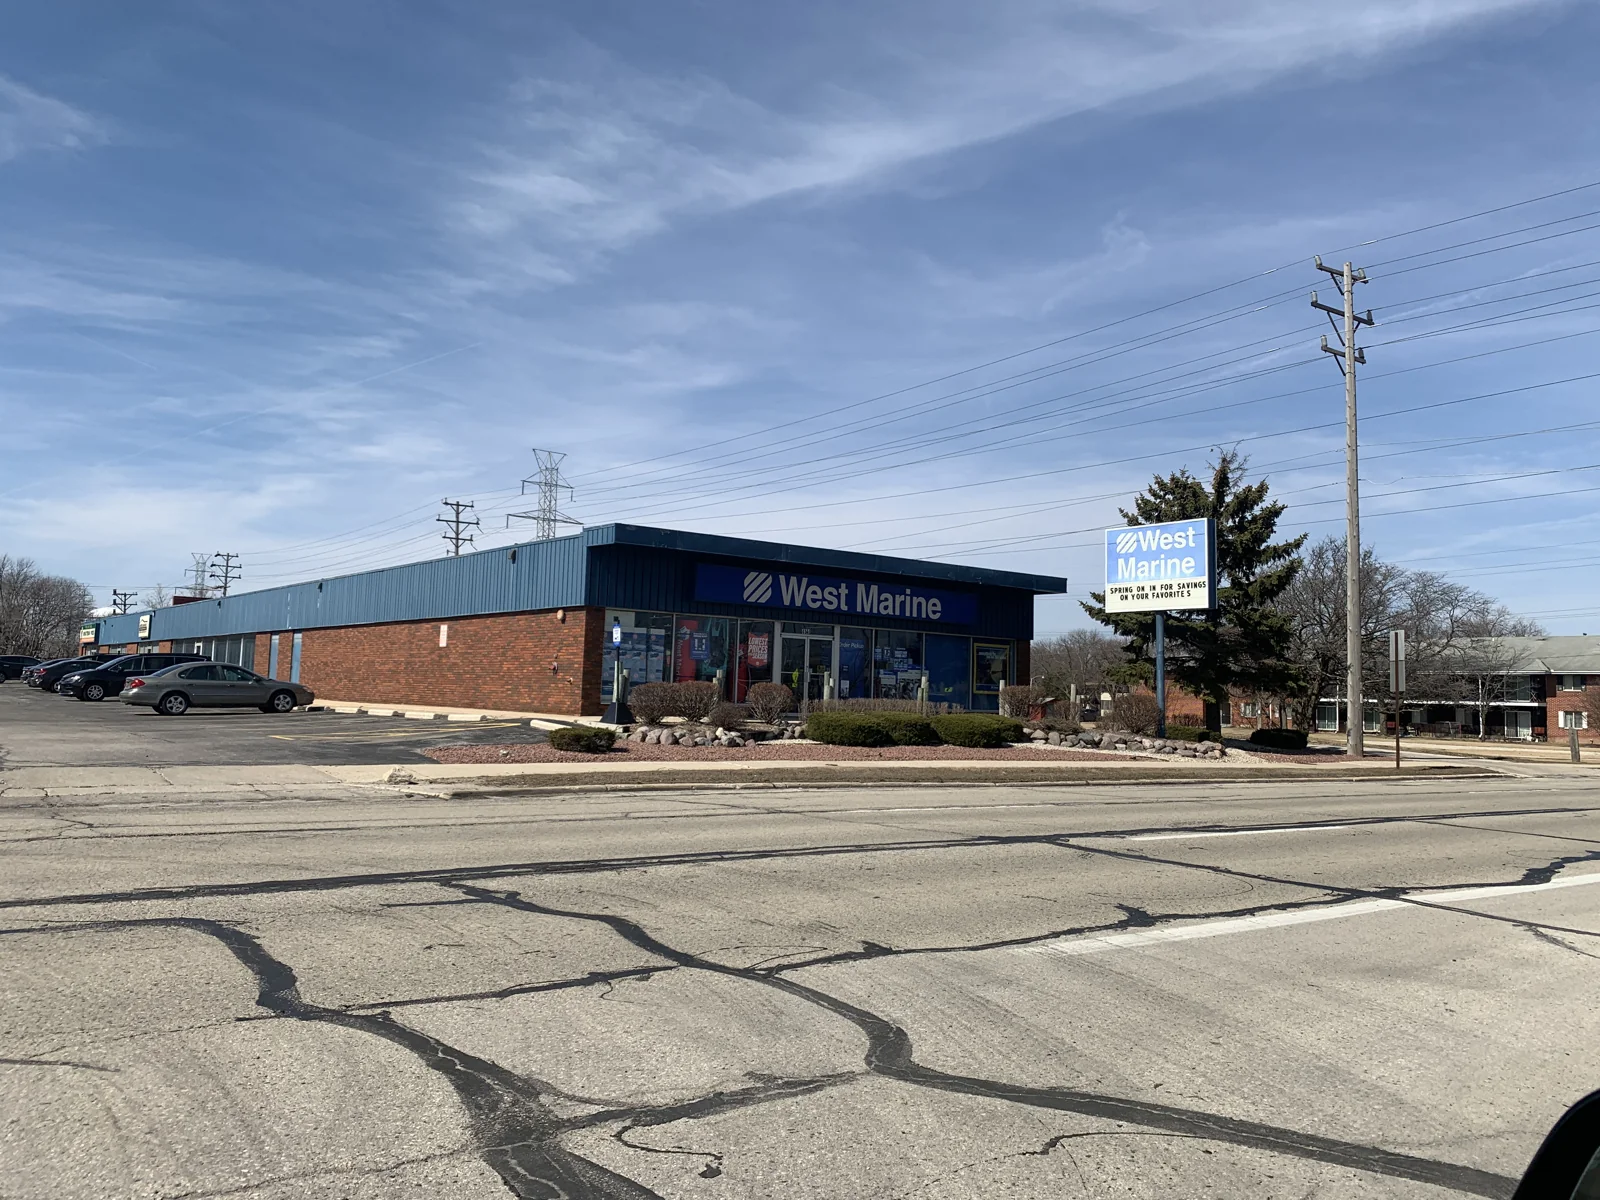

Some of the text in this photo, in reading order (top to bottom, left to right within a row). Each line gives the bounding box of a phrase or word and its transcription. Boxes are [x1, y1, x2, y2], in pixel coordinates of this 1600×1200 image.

[1138, 527, 1196, 552] West
[1117, 554, 1196, 580] Marine
[1110, 586, 1133, 594] SPRING
[1160, 583, 1173, 591] FOR
[1177, 581, 1206, 590] SAVINGS
[779, 574, 942, 620] West Marine
[1131, 592, 1149, 600] YOUR
[748, 637, 768, 646] LOWEST
[748, 644, 768, 653] PRICES
